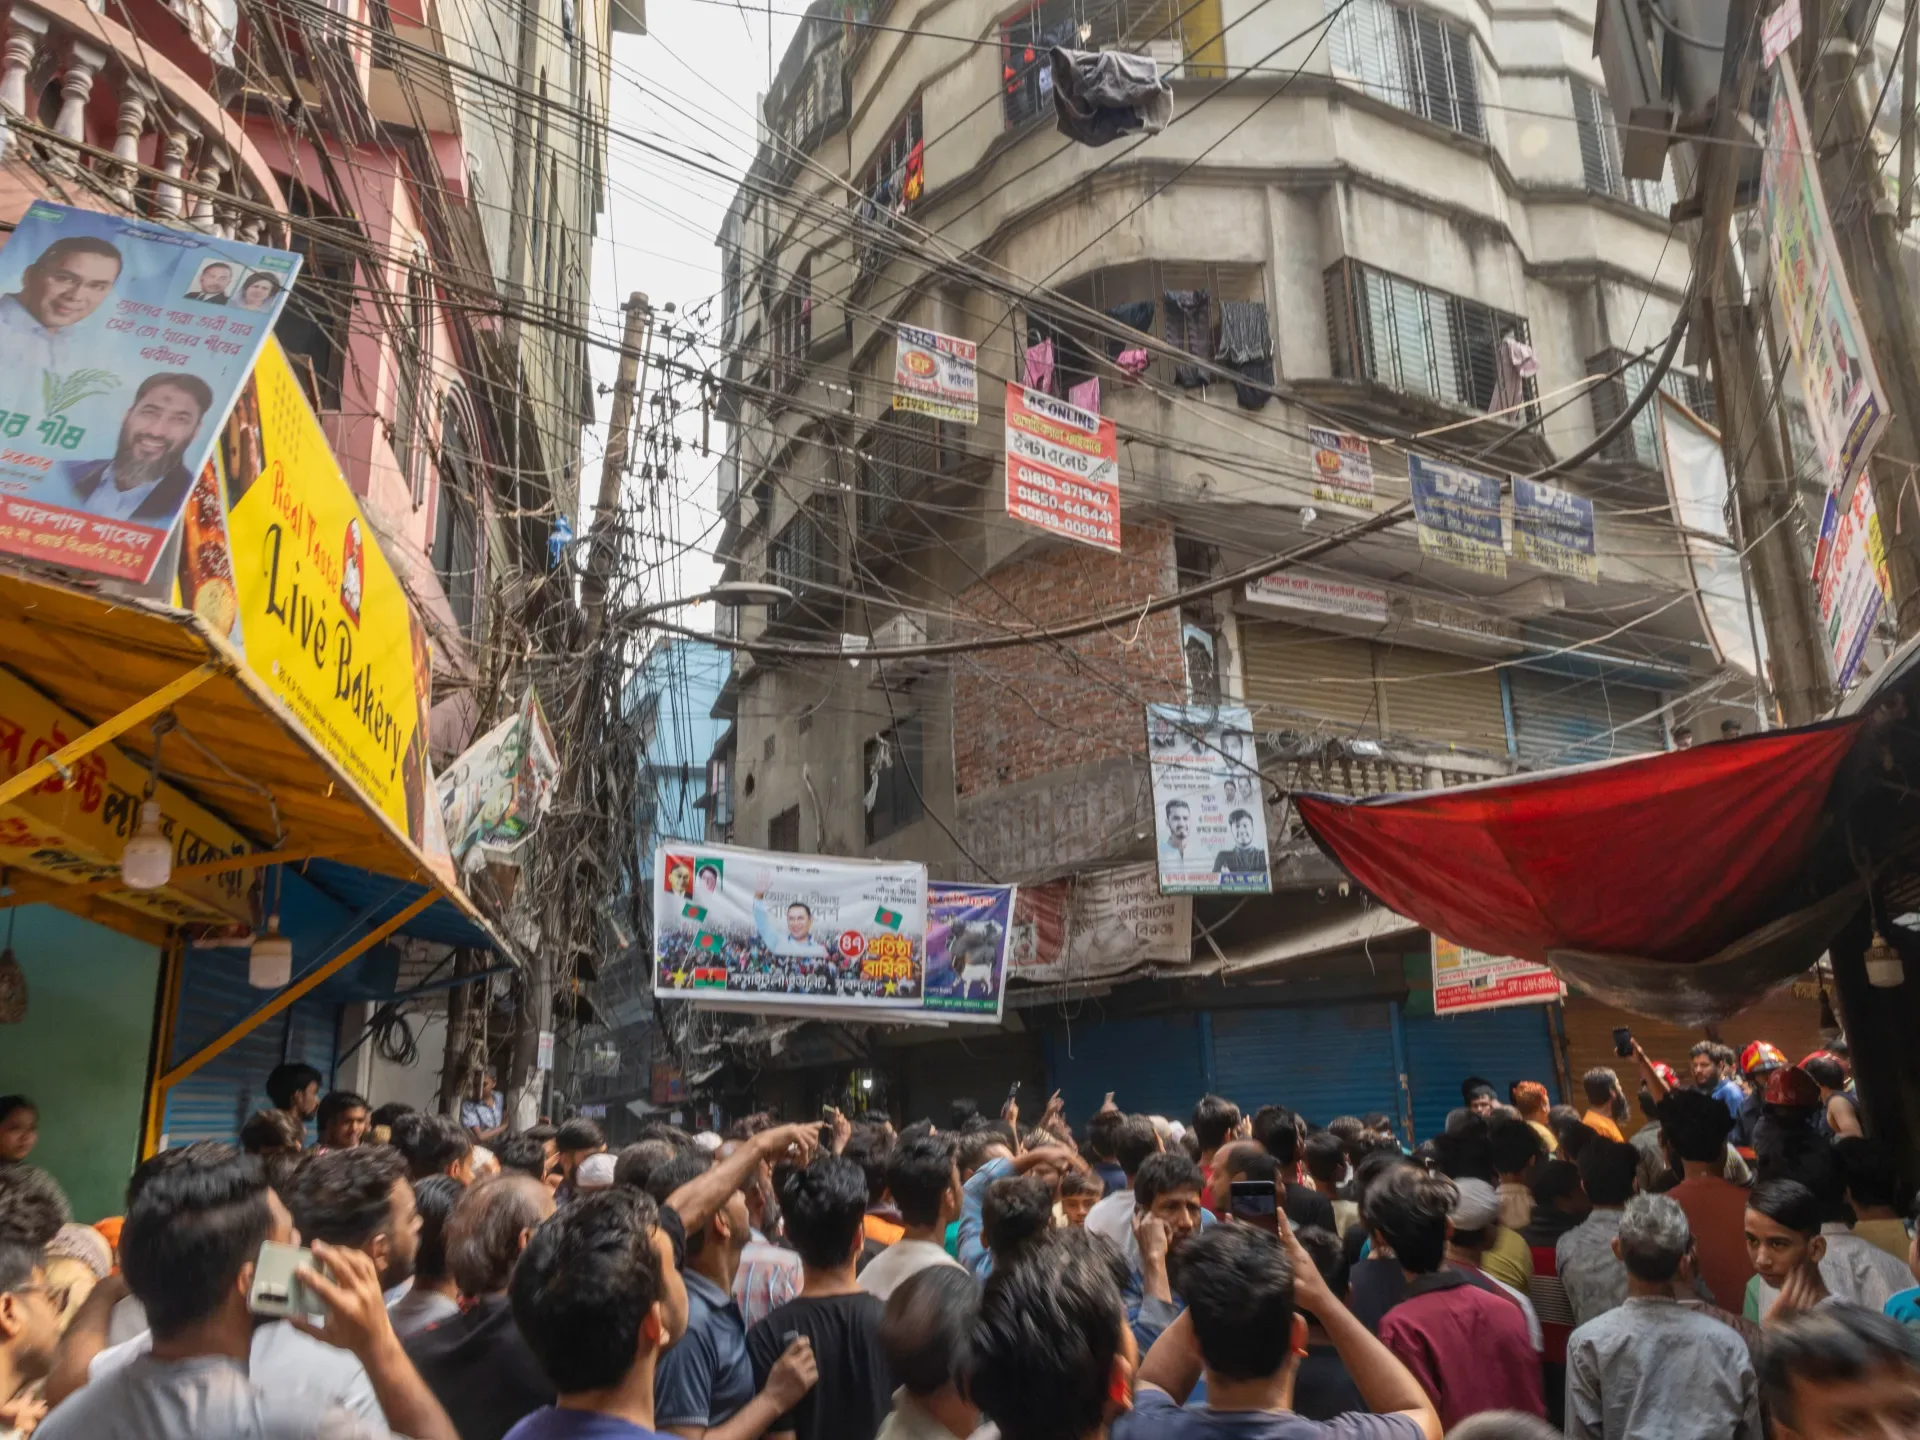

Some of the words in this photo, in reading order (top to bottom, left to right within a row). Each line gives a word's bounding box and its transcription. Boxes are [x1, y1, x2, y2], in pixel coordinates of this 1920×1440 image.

[936, 335, 976, 360] NET
[1029, 395, 1046, 412] AS
[1047, 402, 1095, 431] ONLINE
[1310, 429, 1337, 446] SMS
[841, 935, 862, 952] ৪৭
[866, 932, 914, 959] প্রতিষ্ঠা
[861, 954, 914, 979] বার্ষিকী
